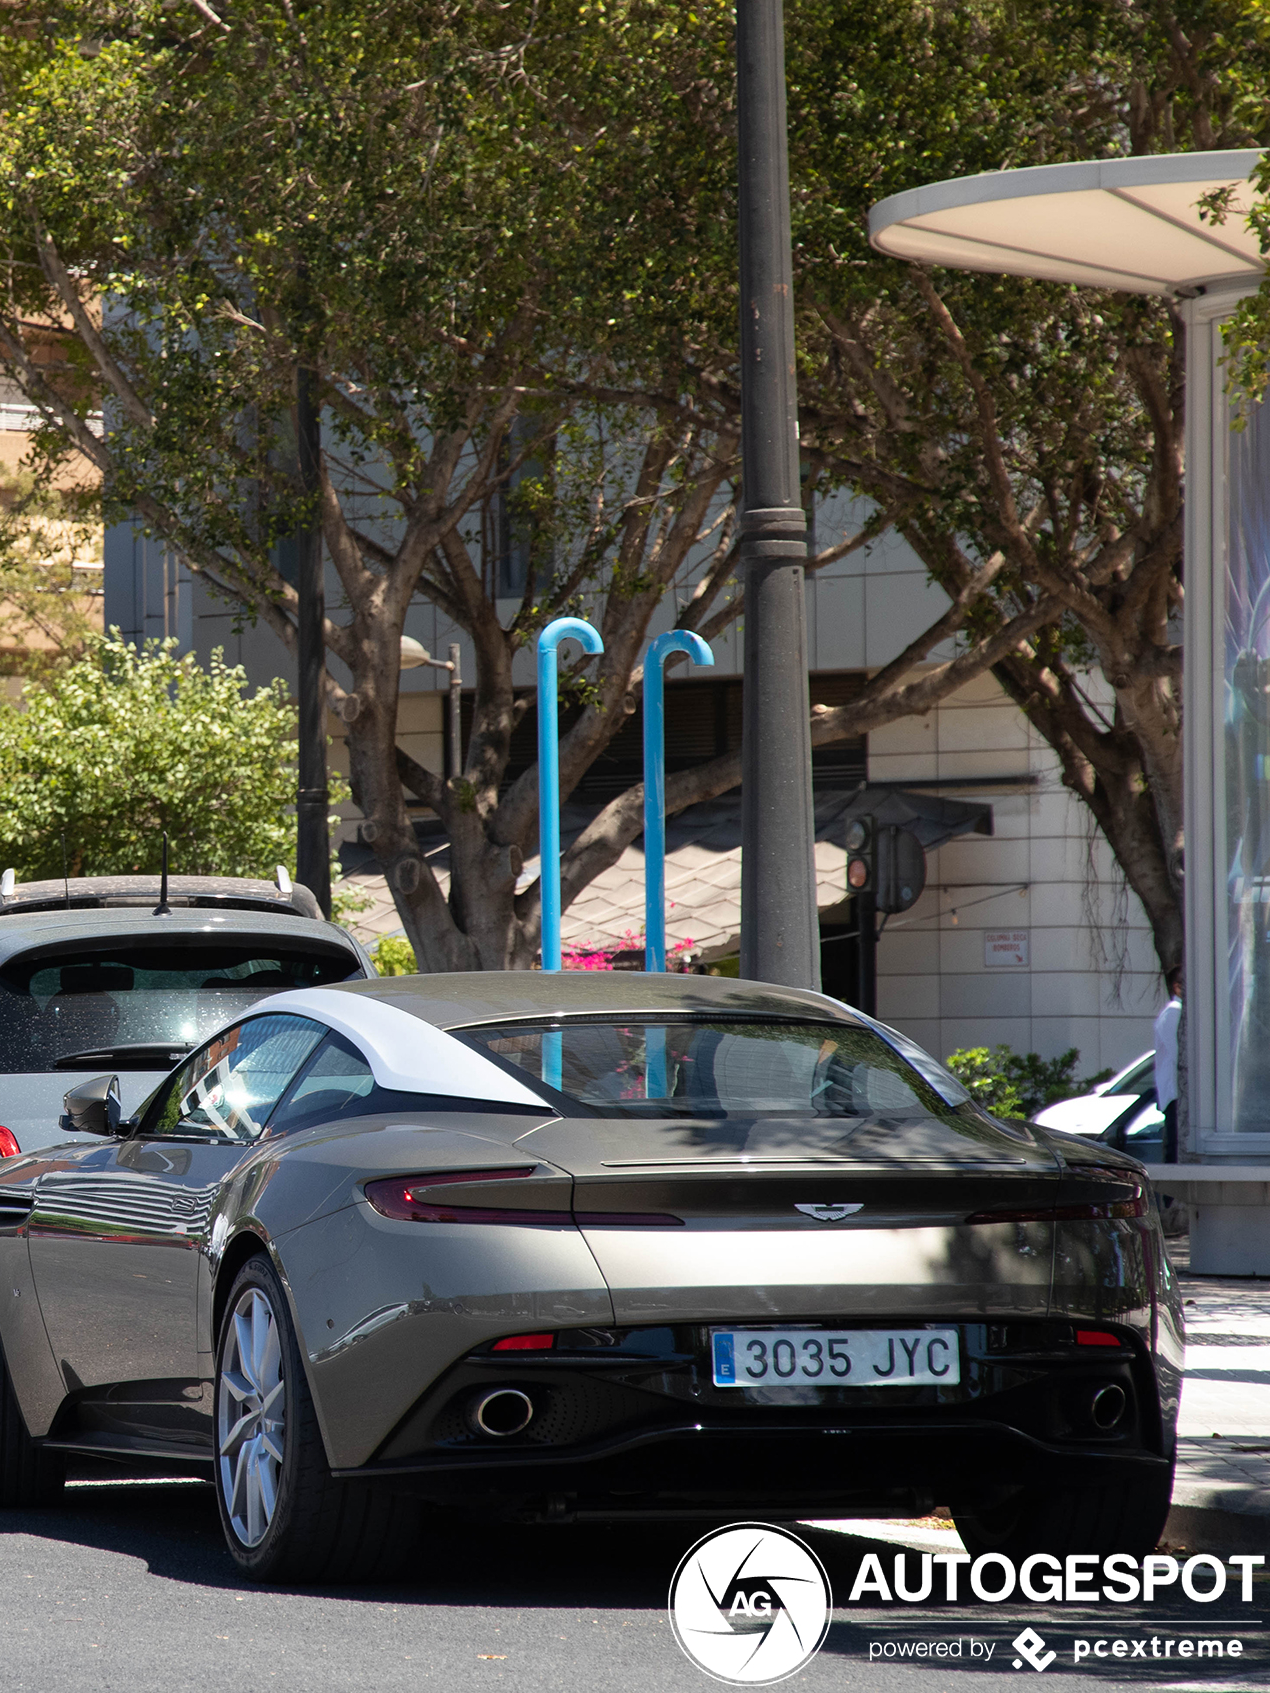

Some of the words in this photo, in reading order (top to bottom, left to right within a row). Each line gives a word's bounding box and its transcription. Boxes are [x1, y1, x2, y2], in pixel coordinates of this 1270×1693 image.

[721, 1364, 730, 1375] E
[745, 1337, 852, 1379] 3035
[872, 1336, 951, 1378] JYC
